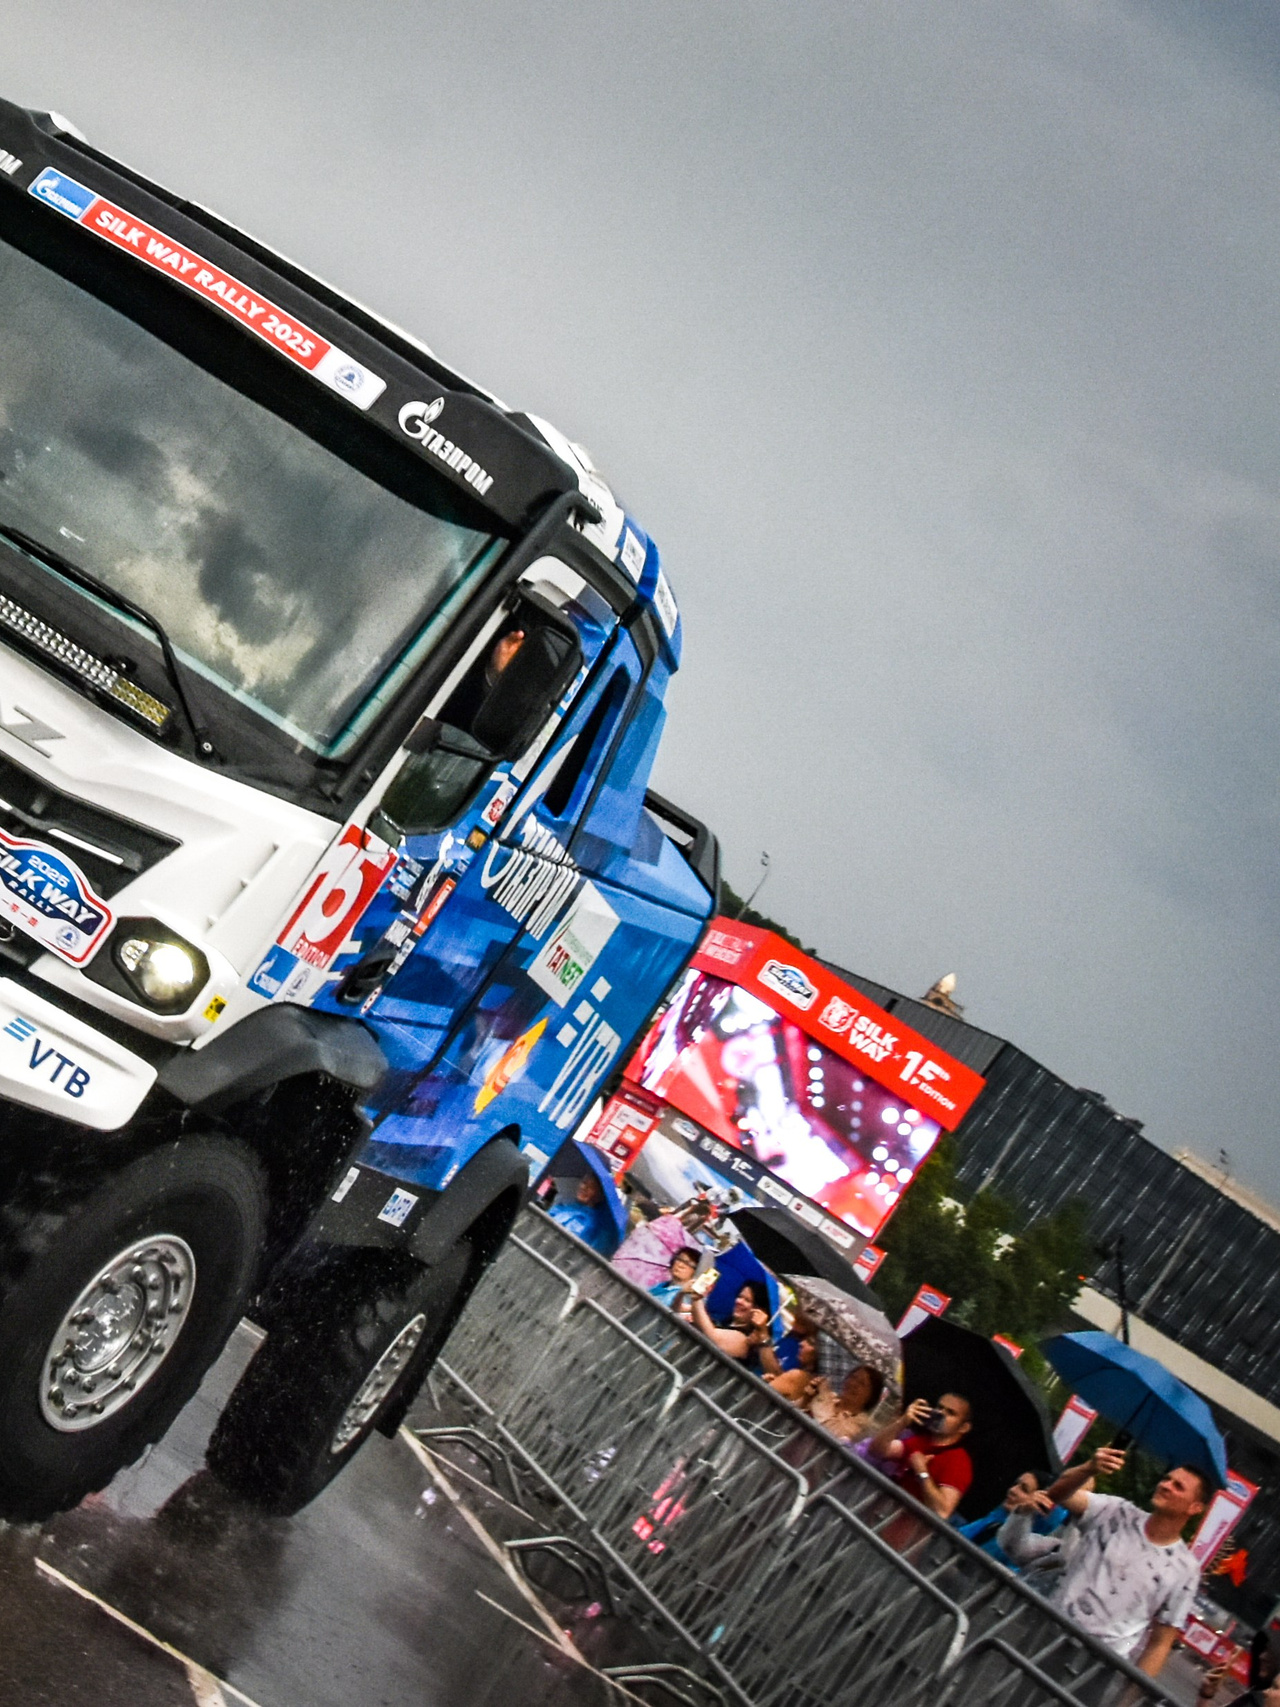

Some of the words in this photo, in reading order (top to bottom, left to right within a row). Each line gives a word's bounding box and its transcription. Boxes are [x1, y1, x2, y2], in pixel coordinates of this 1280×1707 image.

[95, 209, 141, 249] SILK
[143, 236, 195, 274] WAY
[194, 268, 264, 322] RALLY
[260, 312, 316, 358] 2025
[421, 432, 494, 497] ГАЗПРОМ
[25, 854, 72, 888] 2025
[4, 879, 56, 914] RALLY
[36, 881, 100, 929] WAY
[291, 938, 330, 971] EDITION
[544, 944, 585, 989] TATNEFT
[847, 1030, 890, 1065] WAY
[855, 1015, 898, 1051] SILK
[28, 1038, 91, 1099] VTB
[537, 1013, 621, 1129] VTB
[917, 1083, 957, 1112] EDITION
